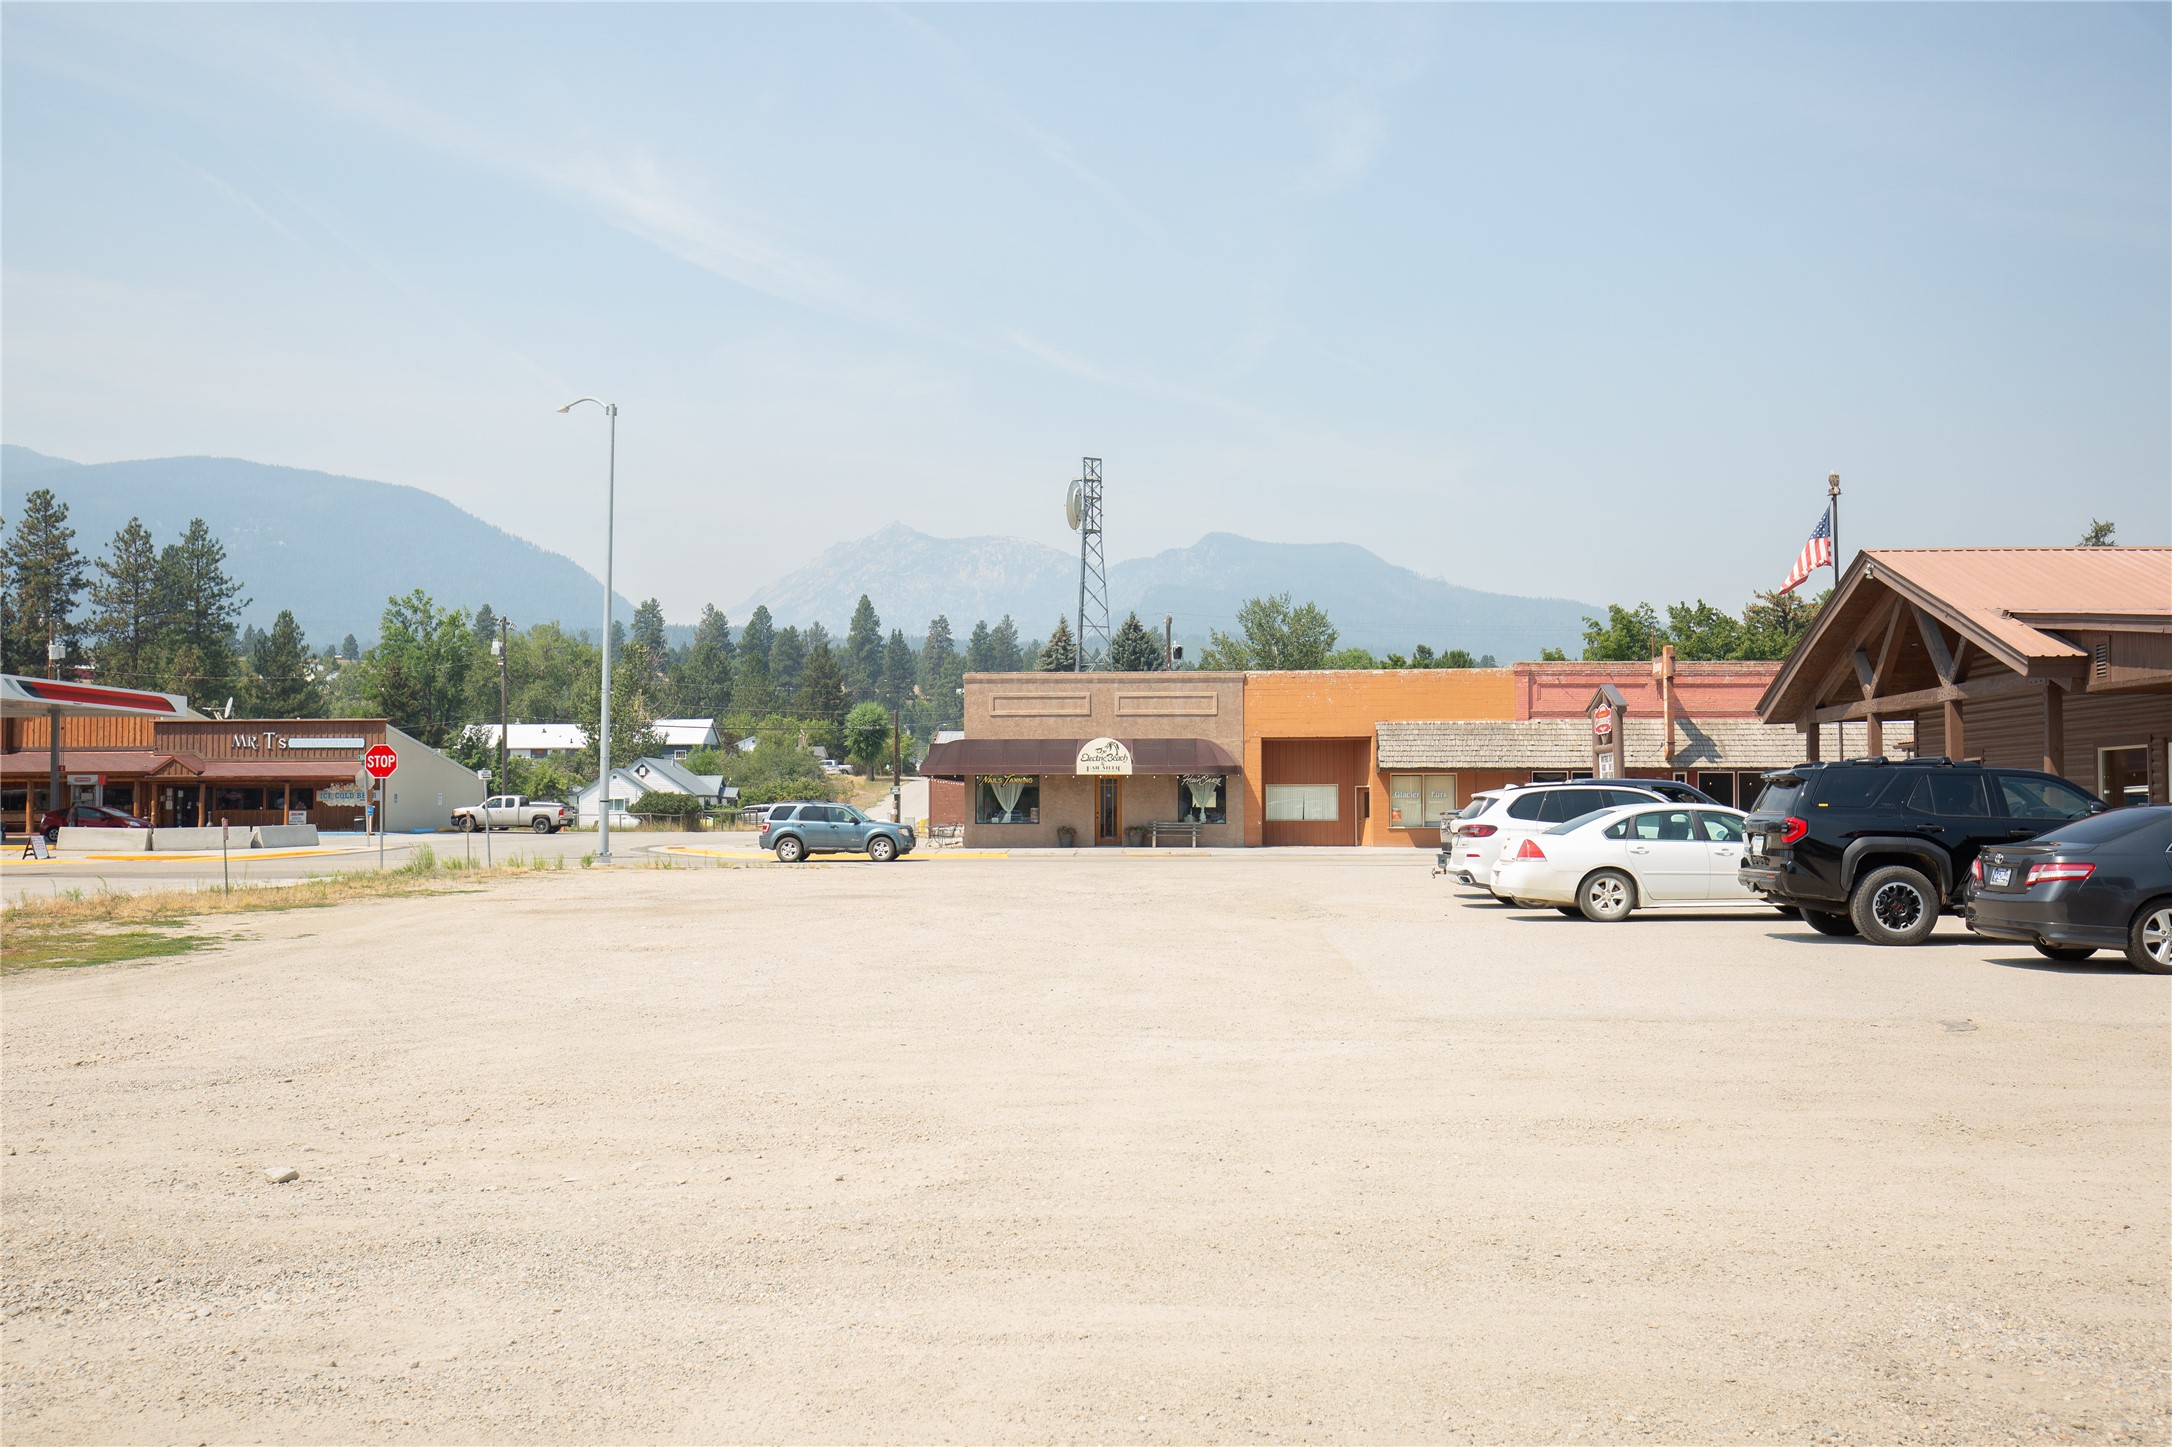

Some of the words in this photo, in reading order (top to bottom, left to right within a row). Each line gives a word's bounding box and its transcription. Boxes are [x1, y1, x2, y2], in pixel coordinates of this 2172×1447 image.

[367, 755, 396, 768] STOP
[1080, 753, 1106, 763] Electric
[1106, 753, 1129, 763] Beach
